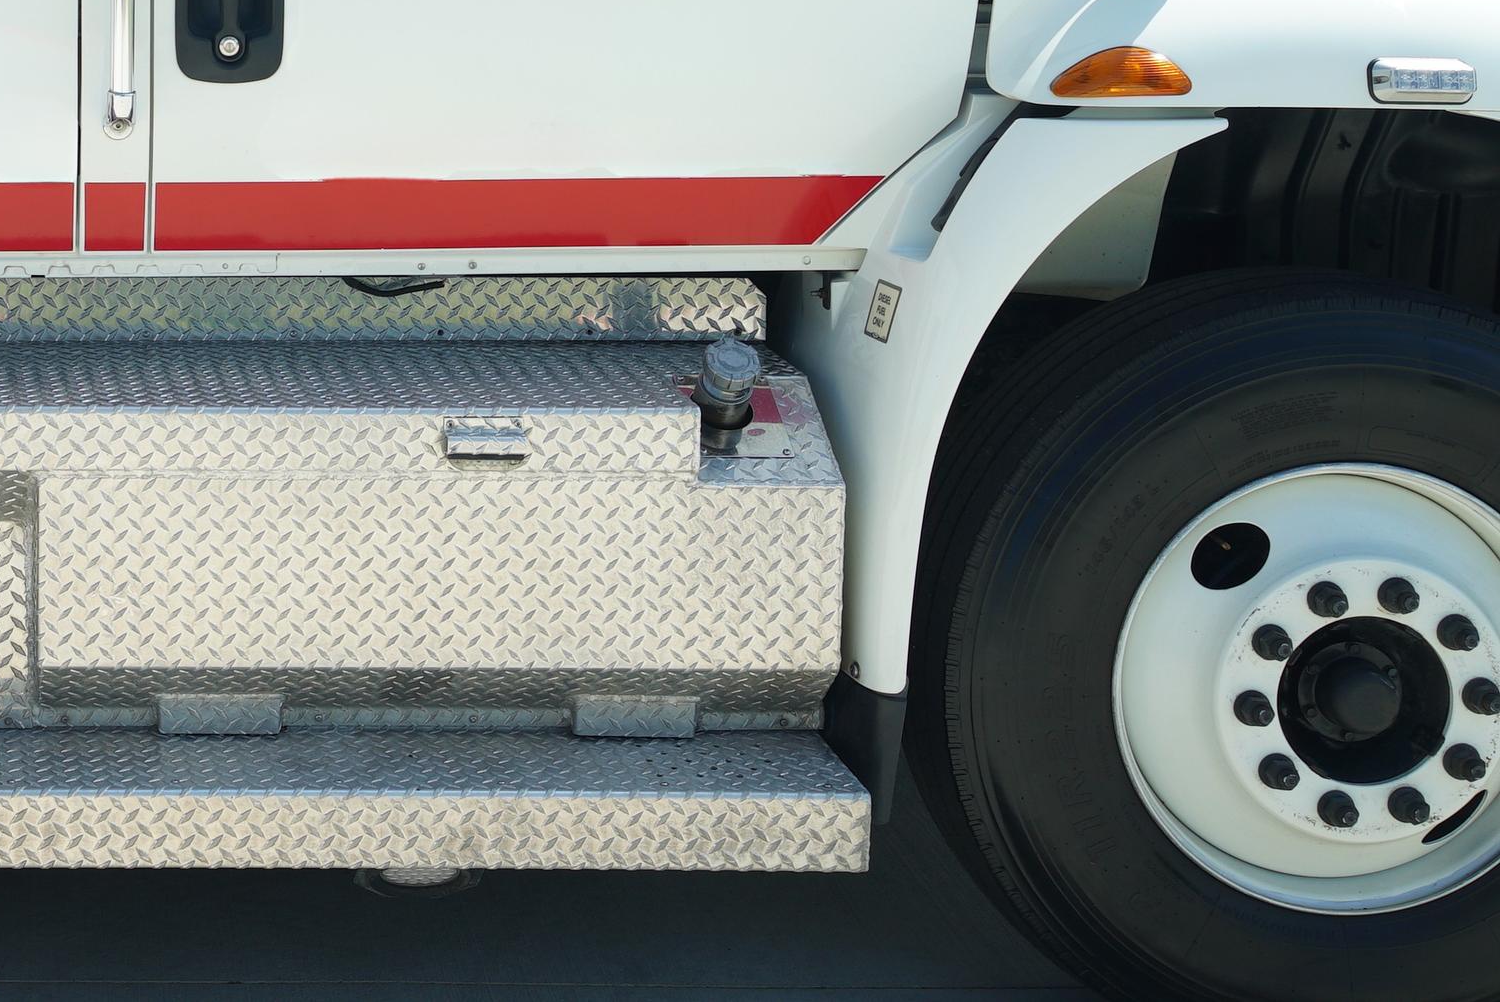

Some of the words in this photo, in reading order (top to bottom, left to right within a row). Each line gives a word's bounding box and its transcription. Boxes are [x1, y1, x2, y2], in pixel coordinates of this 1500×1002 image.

[878, 292, 891, 305] DIESEL
[876, 304, 886, 316] FUEL
[872, 316, 885, 328] ONLY
